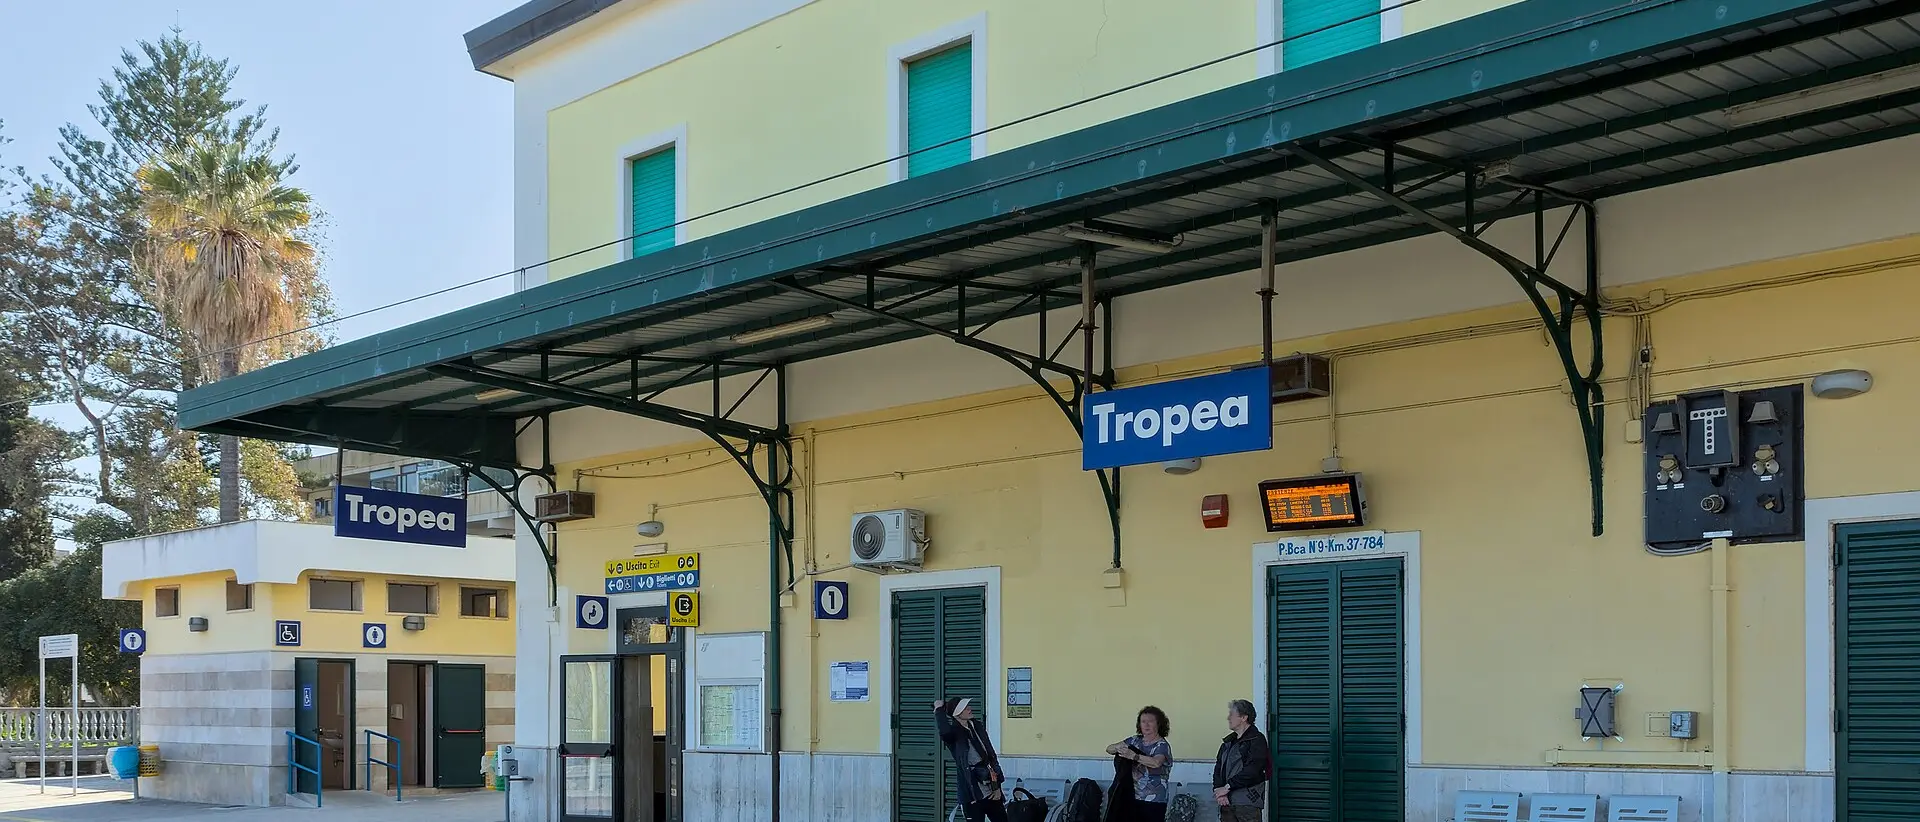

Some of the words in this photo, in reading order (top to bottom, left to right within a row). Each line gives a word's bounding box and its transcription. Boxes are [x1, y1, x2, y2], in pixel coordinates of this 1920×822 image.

[1092, 395, 1249, 447] Tropea
[345, 494, 455, 534] Tropea
[626, 561, 647, 571] Uscita
[649, 560, 660, 569] Exit
[656, 574, 676, 584] Biglietti
[828, 590, 835, 610] 1
